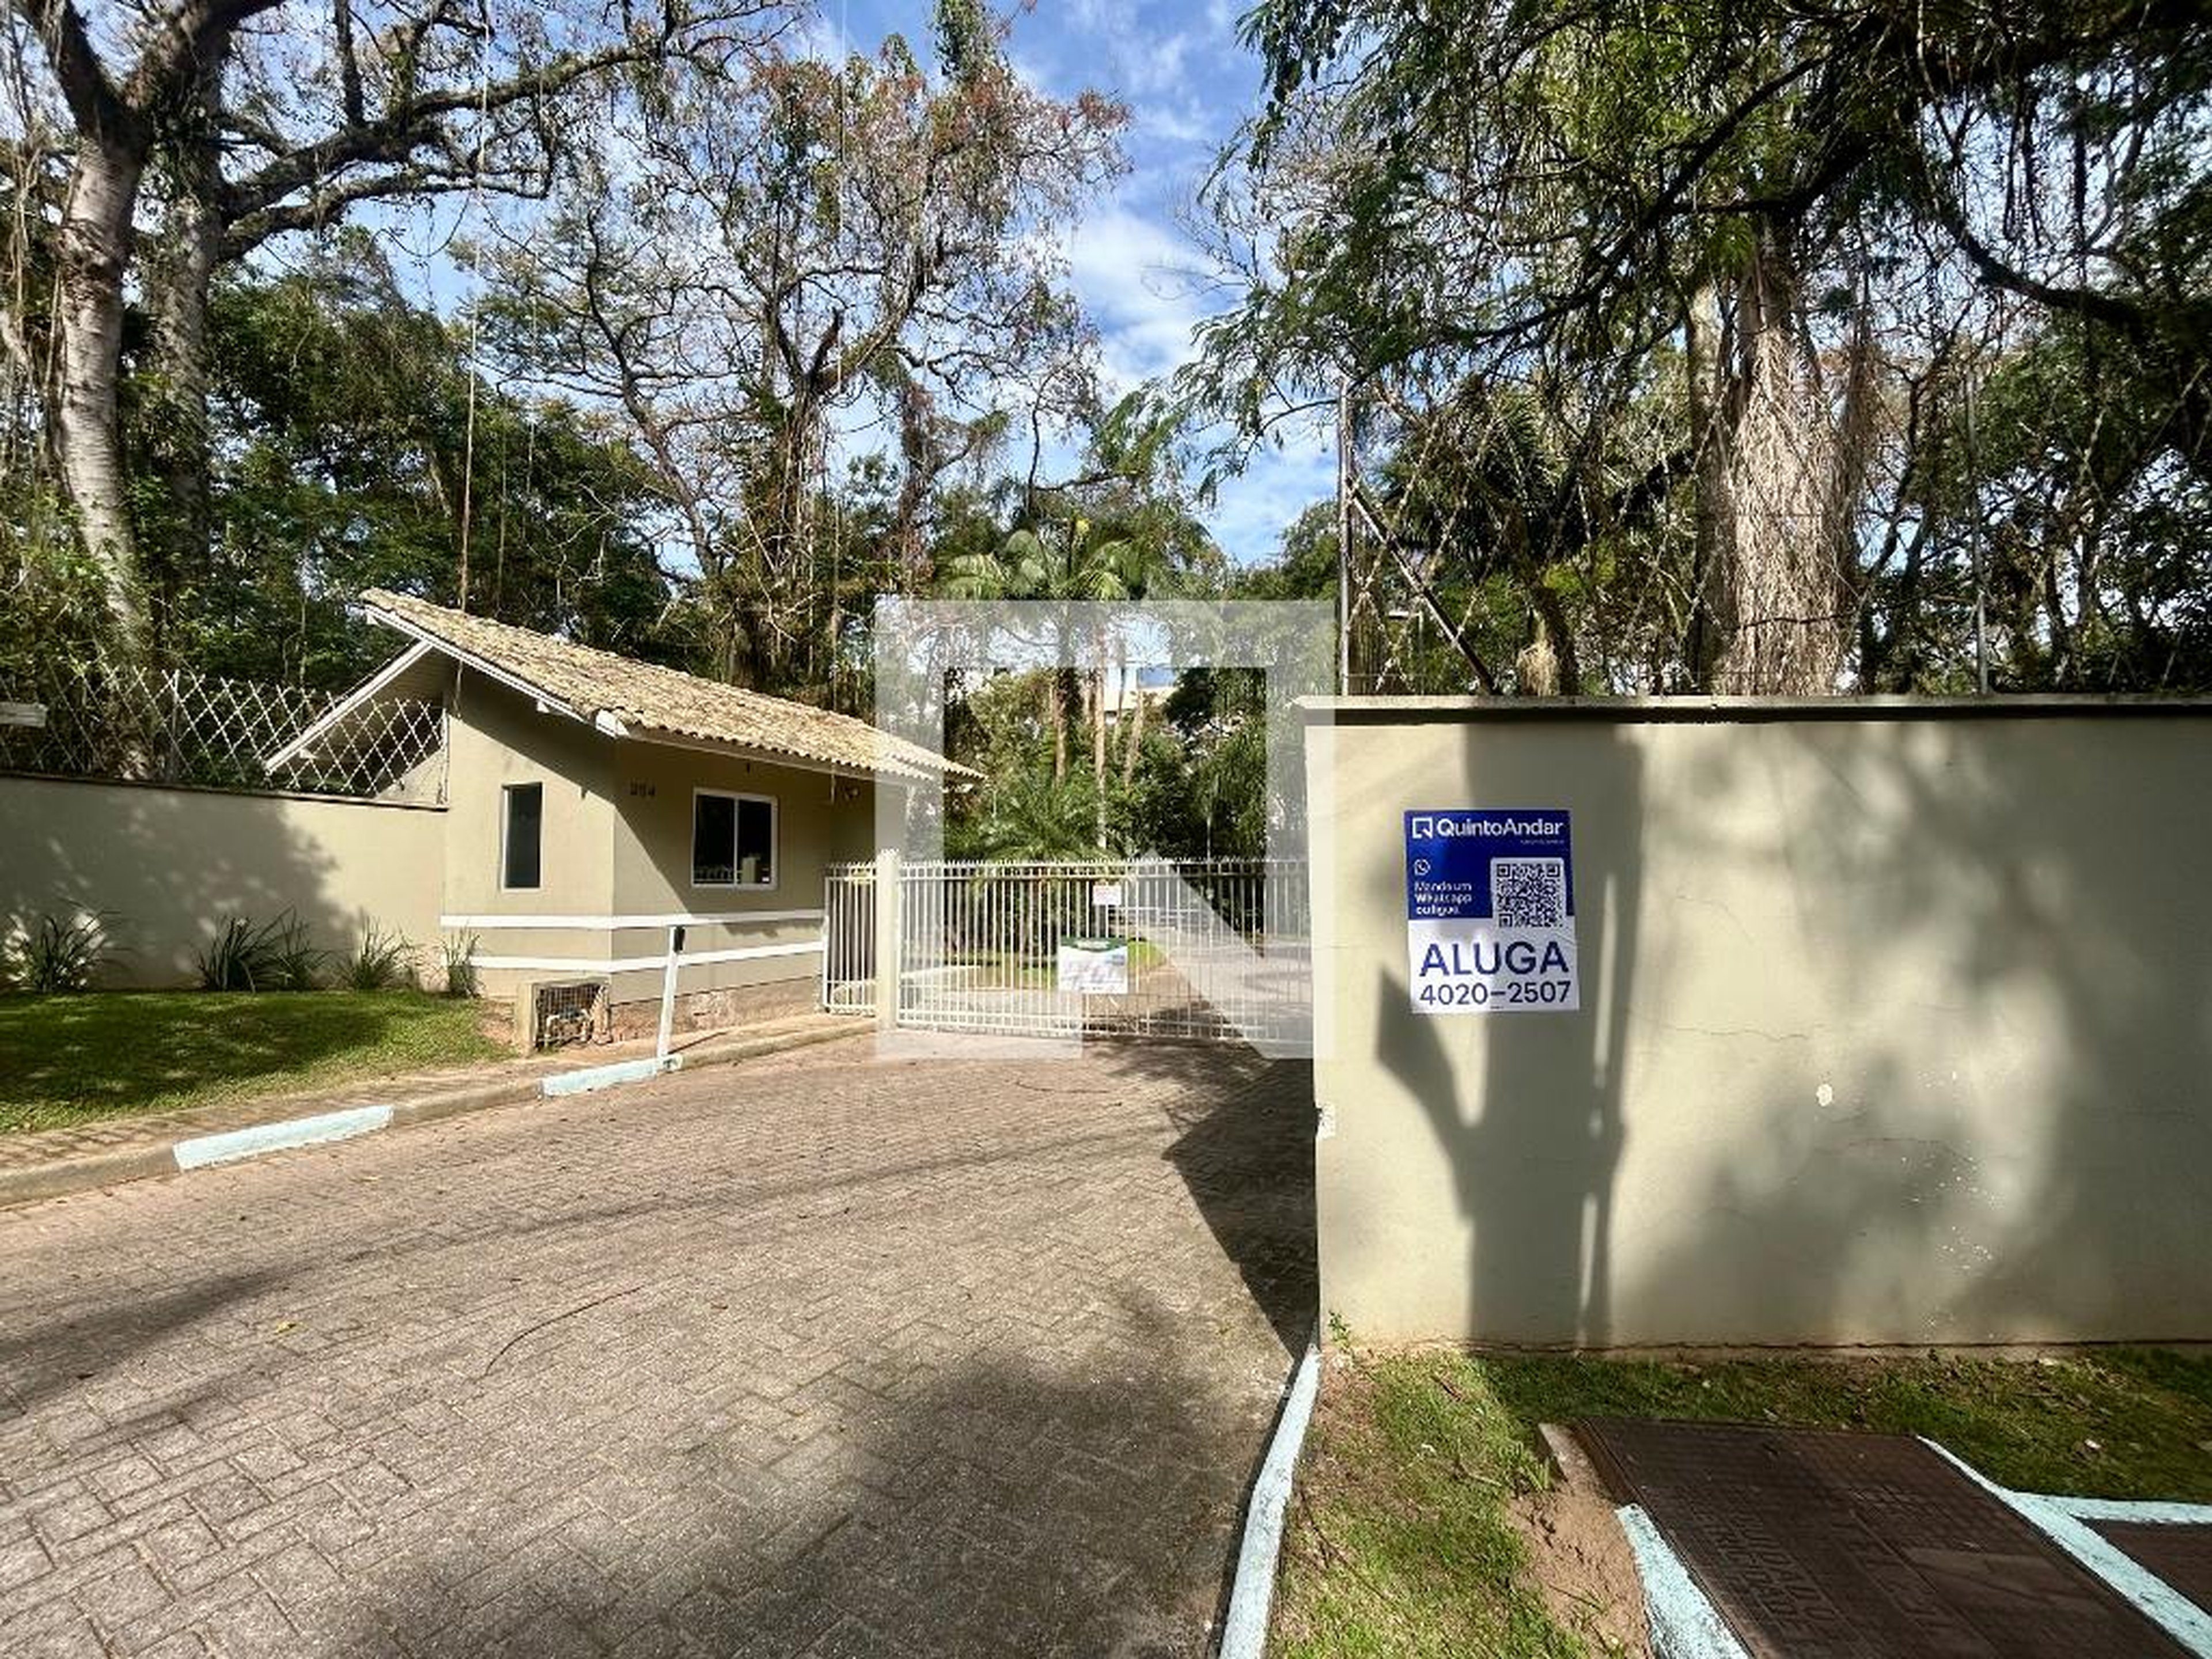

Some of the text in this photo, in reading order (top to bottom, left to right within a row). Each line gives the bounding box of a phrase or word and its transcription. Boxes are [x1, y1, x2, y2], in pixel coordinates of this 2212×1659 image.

[1437, 818, 1563, 837] QuintoAndar
[1453, 882, 1472, 891] um
[1419, 941, 1569, 977] ALUGA
[1419, 980, 1571, 1006] 4020-2507
